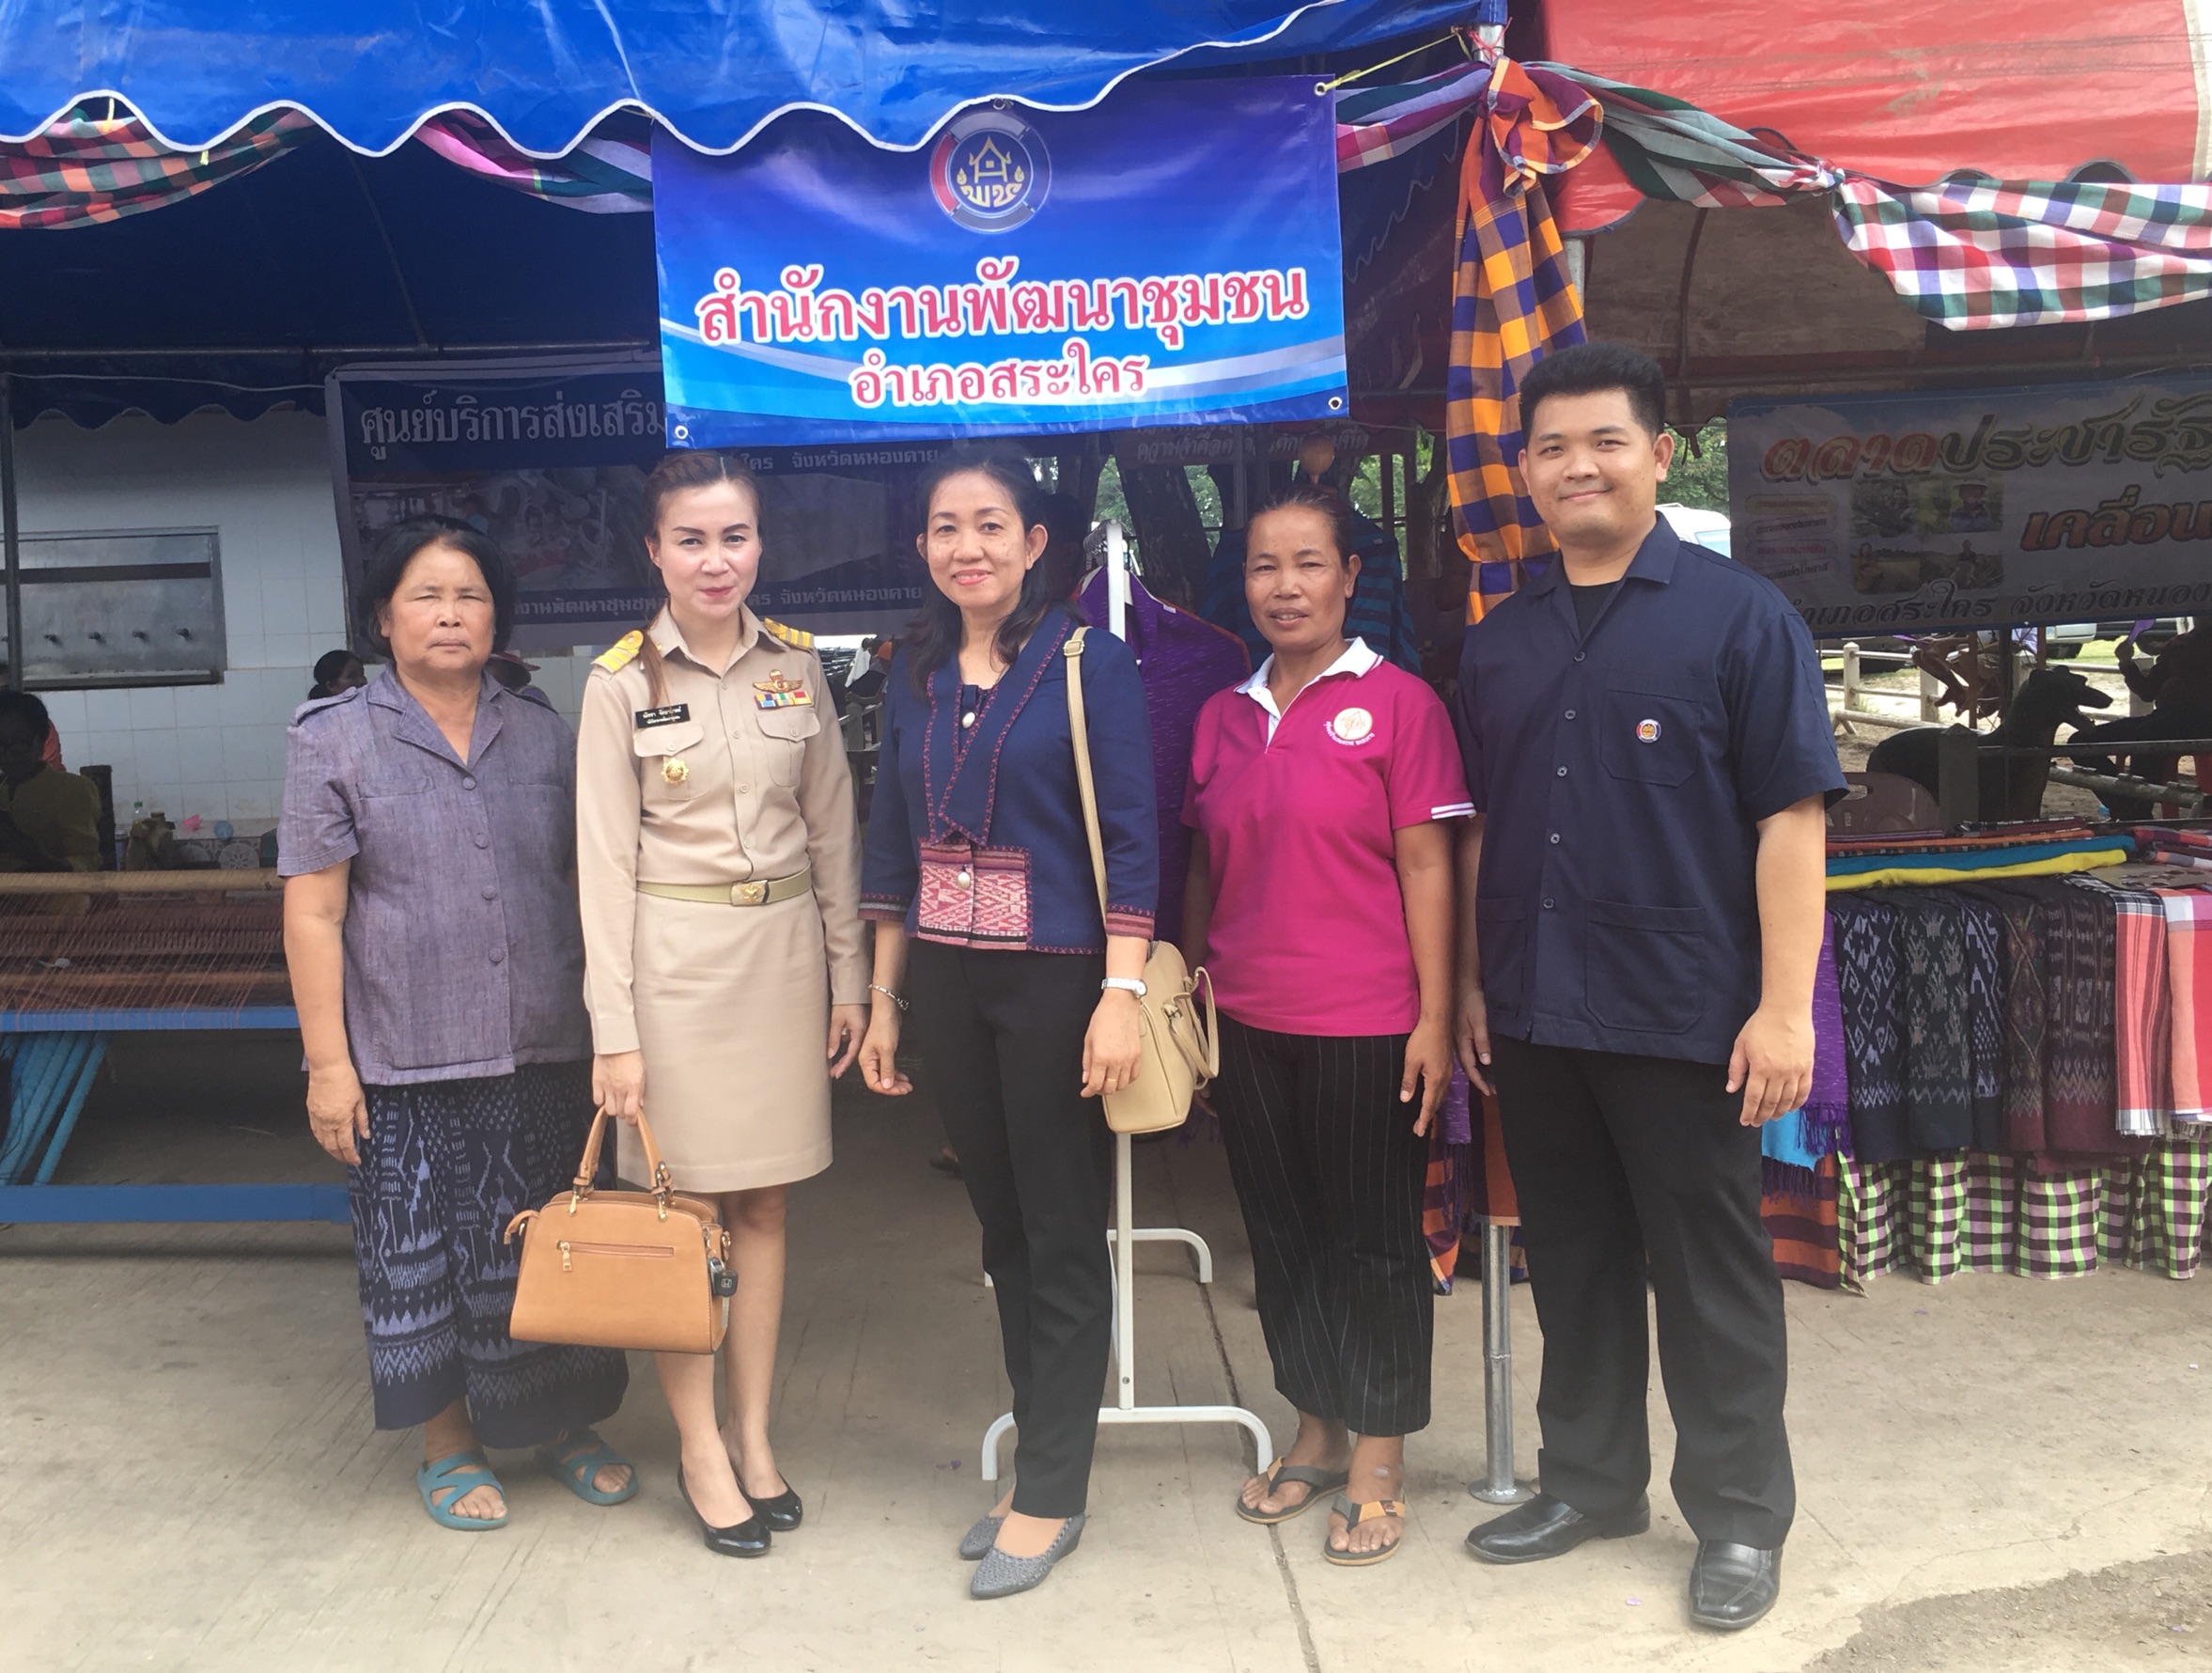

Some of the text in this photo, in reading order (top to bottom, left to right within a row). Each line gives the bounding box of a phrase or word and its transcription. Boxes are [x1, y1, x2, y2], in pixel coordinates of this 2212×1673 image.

[695, 256, 1310, 349] สำนักงานพัฒนาชุมชน
[848, 338, 1150, 408] อำเภอสระใคร
[791, 449, 939, 469] จังหวัดหนองคาย
[513, 597, 657, 617] งานพัฒนาชุมชน
[780, 586, 922, 606] จังหวัดหนองคาย
[1793, 579, 1999, 628] ำเภอสระใคร
